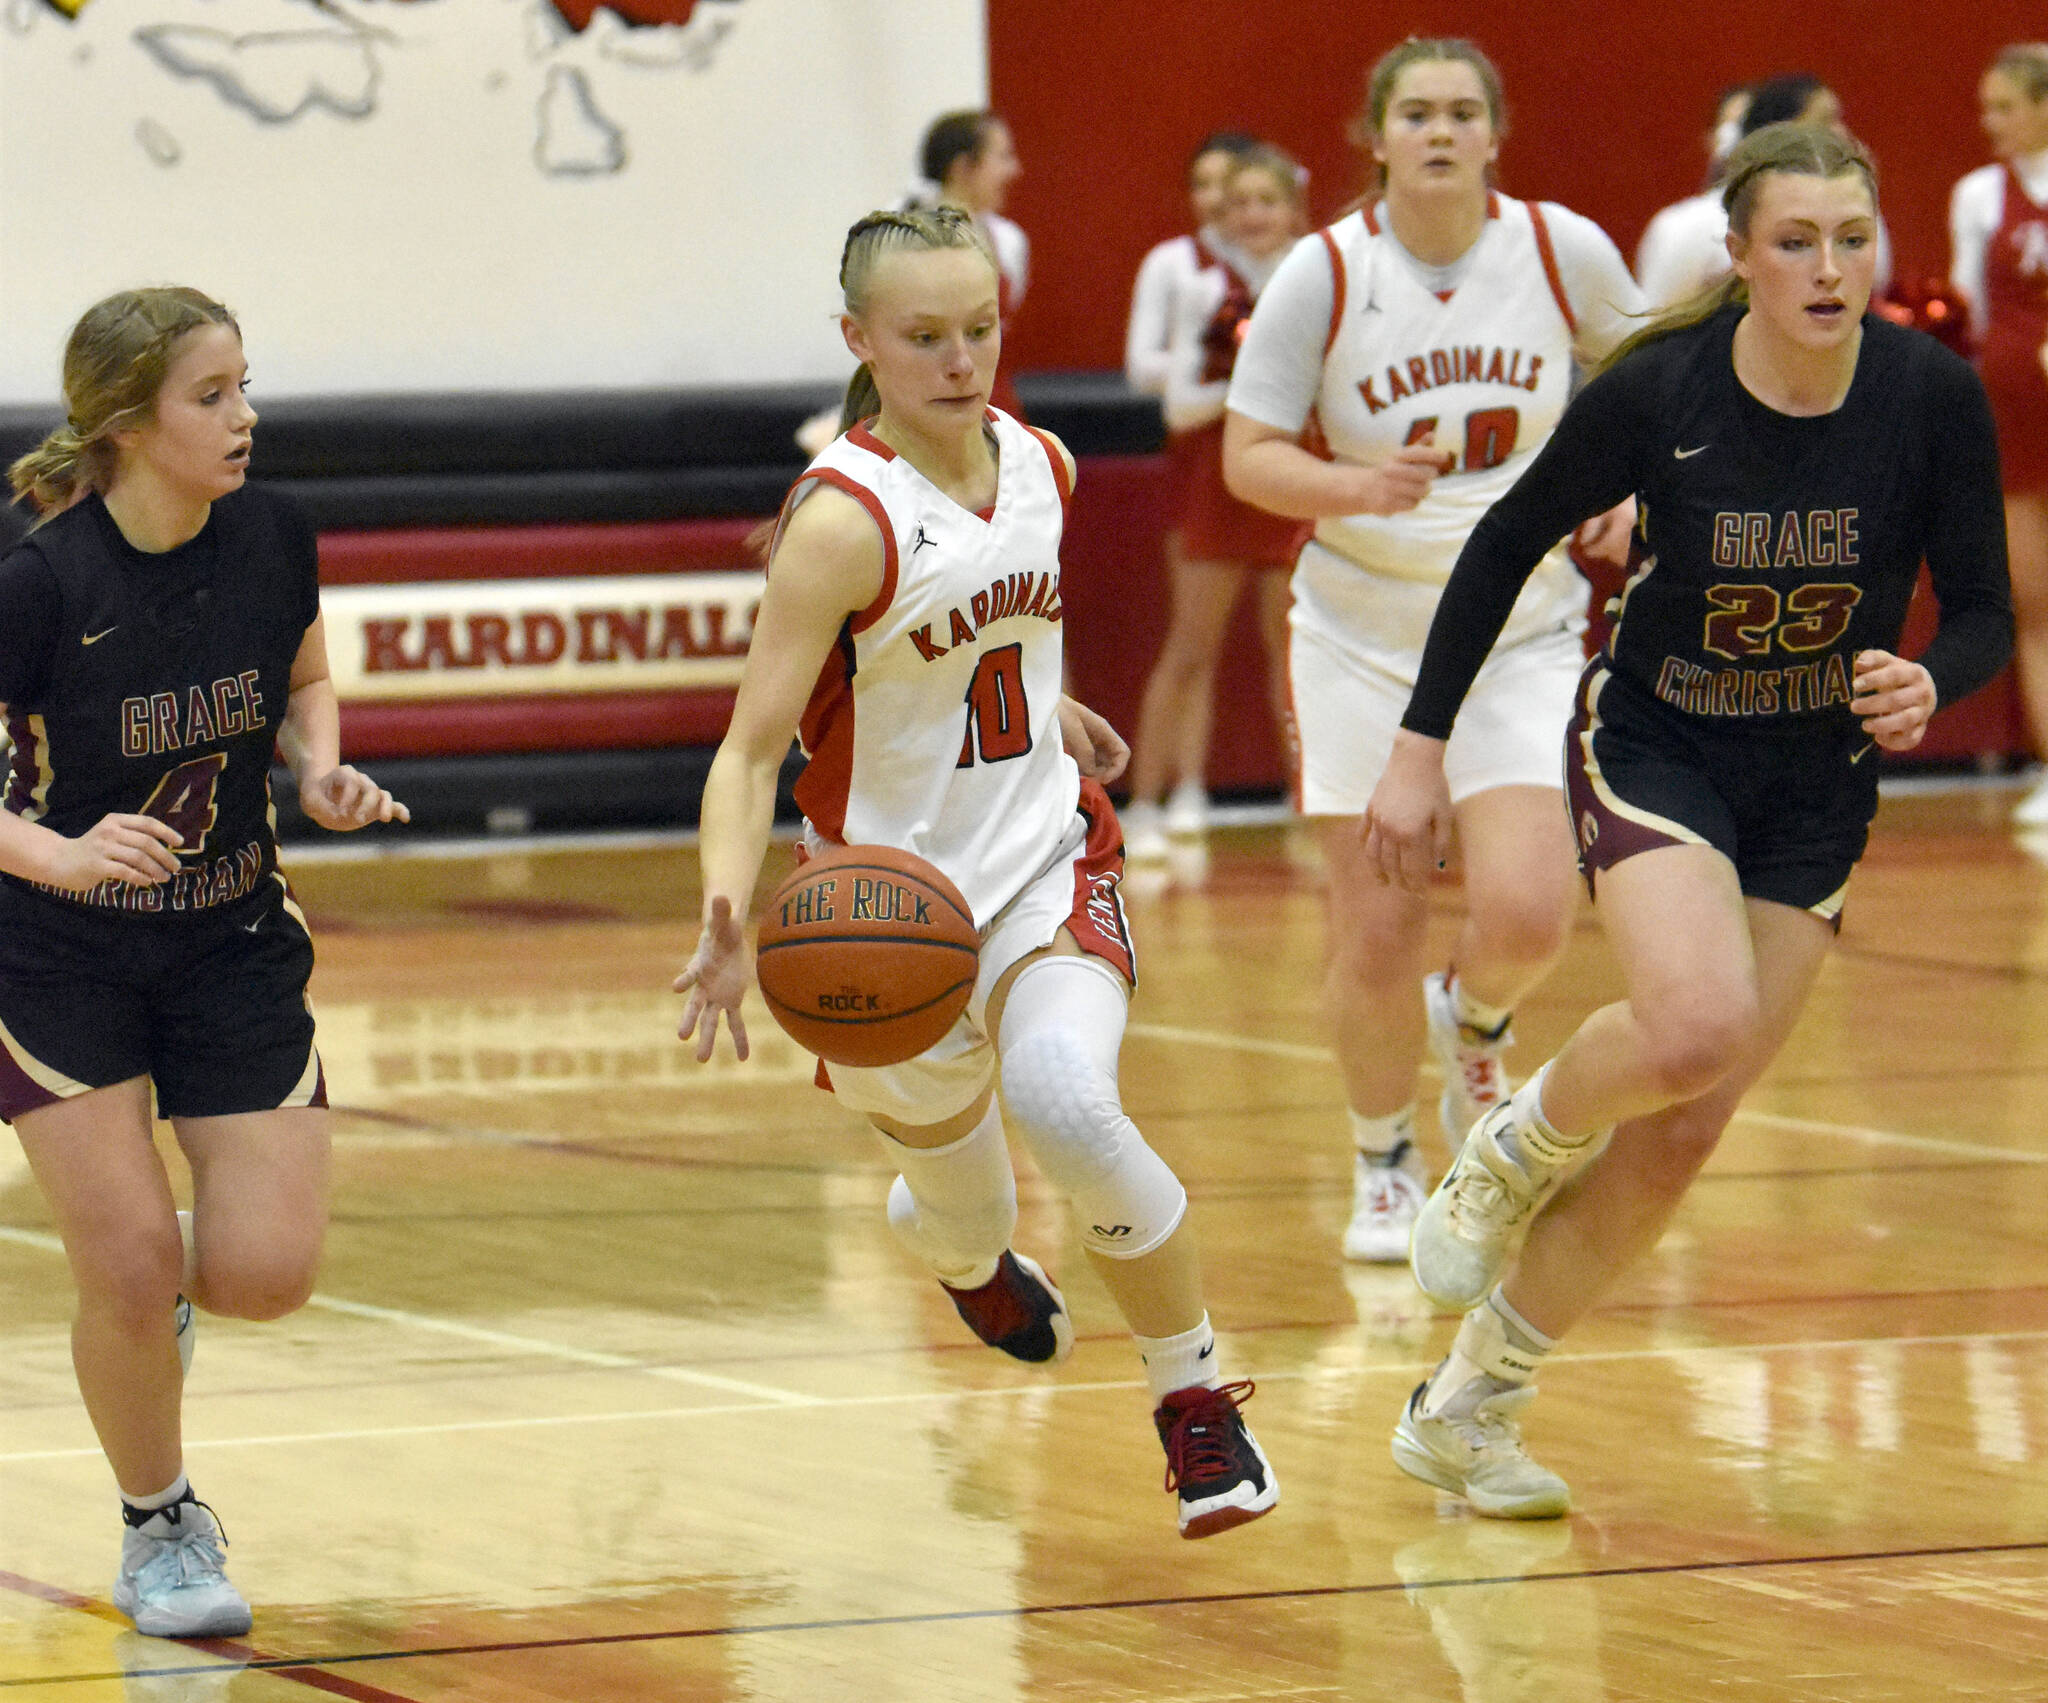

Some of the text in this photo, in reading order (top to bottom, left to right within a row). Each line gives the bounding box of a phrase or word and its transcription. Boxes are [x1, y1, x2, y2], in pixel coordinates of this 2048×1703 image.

[1357, 345, 1546, 415] KARDINALS
[1713, 508, 1861, 568] GRACE
[363, 603, 758, 673] KARDINAL
[1703, 583, 1864, 661] 23
[121, 670, 266, 757] GRACE
[1655, 653, 1861, 716] CHRISTIA
[138, 752, 228, 855] 4
[33, 841, 262, 913] RISTIAN
[780, 877, 932, 928] THE ROCK
[818, 993, 880, 1012] ROCK
